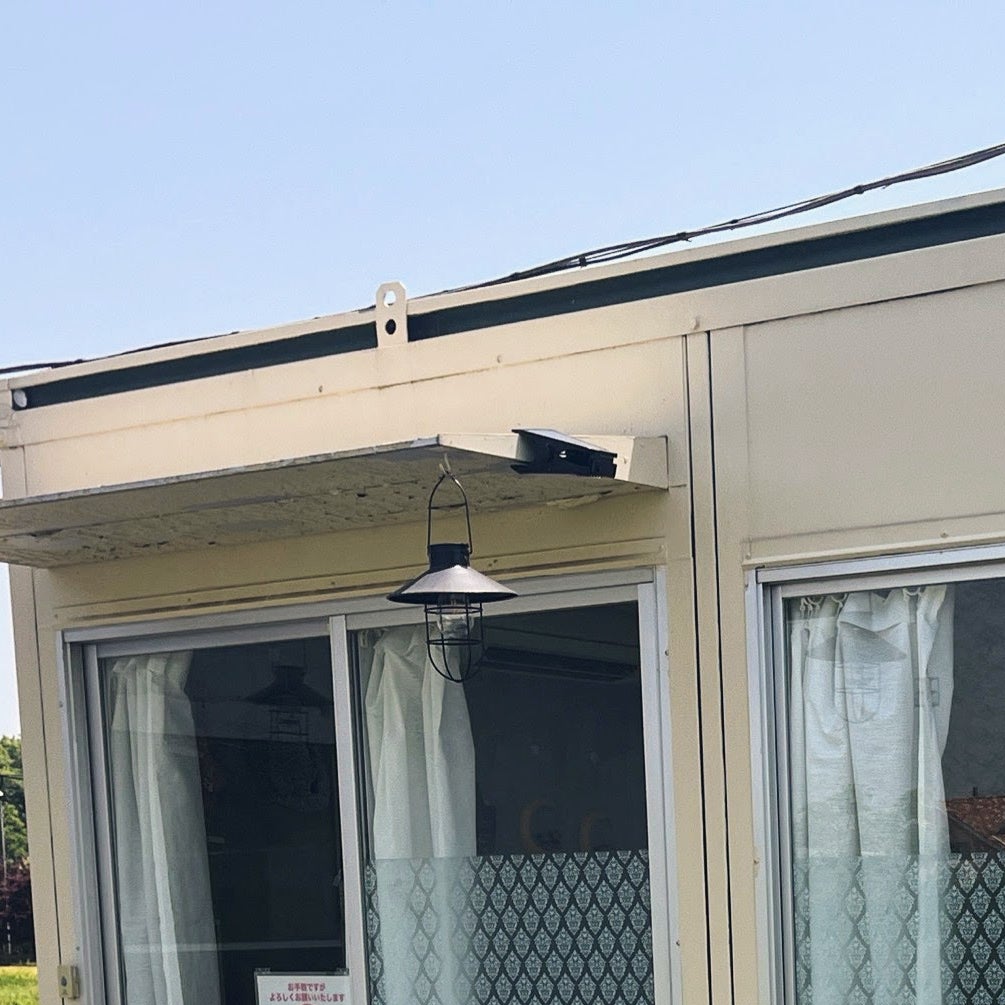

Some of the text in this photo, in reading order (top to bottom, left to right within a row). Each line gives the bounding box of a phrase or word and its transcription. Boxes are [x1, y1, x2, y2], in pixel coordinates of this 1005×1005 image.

[287, 982, 326, 992] お手数ですが
[269, 992, 345, 1002] よろしくお願いいたします
